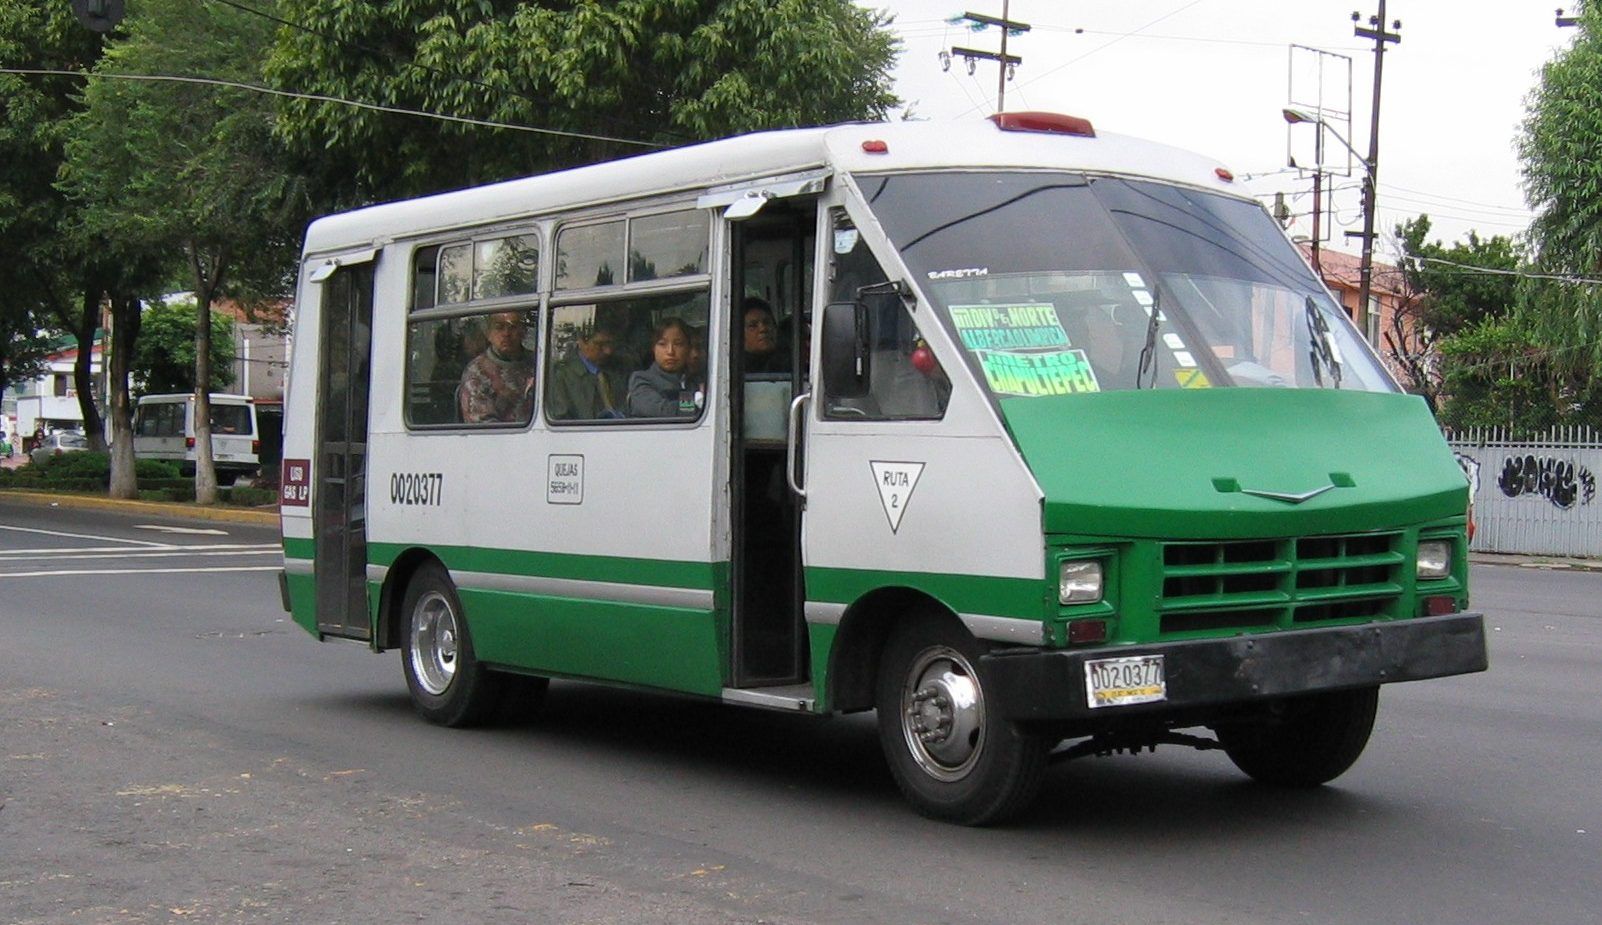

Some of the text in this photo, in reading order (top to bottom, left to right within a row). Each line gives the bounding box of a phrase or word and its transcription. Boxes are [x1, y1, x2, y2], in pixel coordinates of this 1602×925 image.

[1006, 305, 1059, 327] NORTE
[555, 463, 578, 477] QUEJAS
[883, 471, 909, 487] RUTA
[391, 472, 443, 506] 0020377
[891, 493, 898, 508] 2
